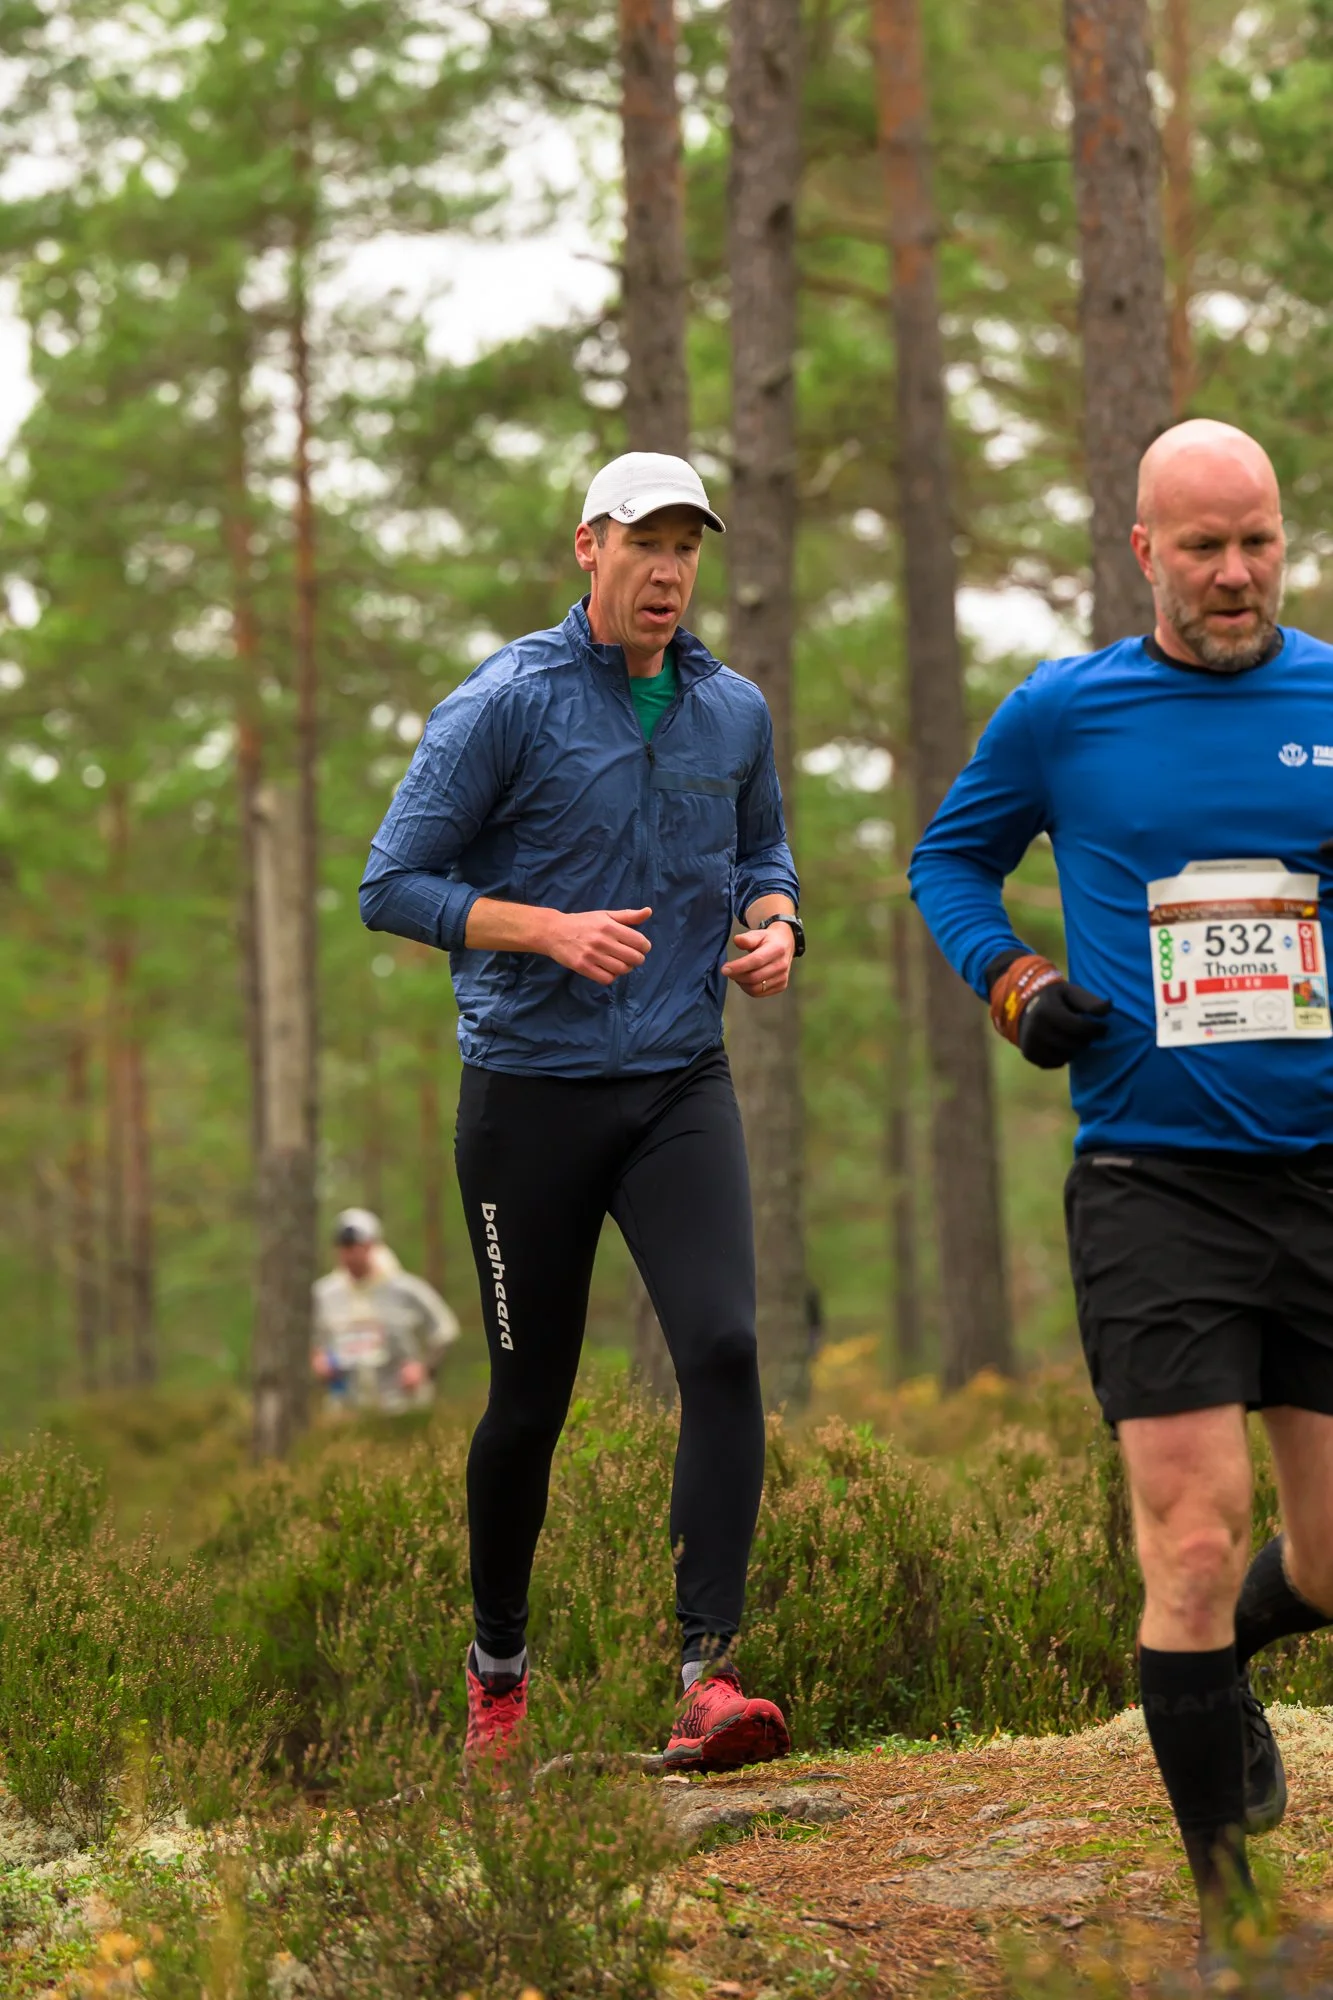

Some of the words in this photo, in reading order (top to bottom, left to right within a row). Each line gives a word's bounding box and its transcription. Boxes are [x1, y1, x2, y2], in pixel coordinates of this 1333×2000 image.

[1158, 928, 1174, 981] coop
[1205, 924, 1274, 957] 532
[1204, 962, 1278, 978] Thomas
[481, 1202, 514, 1351] bagheera
